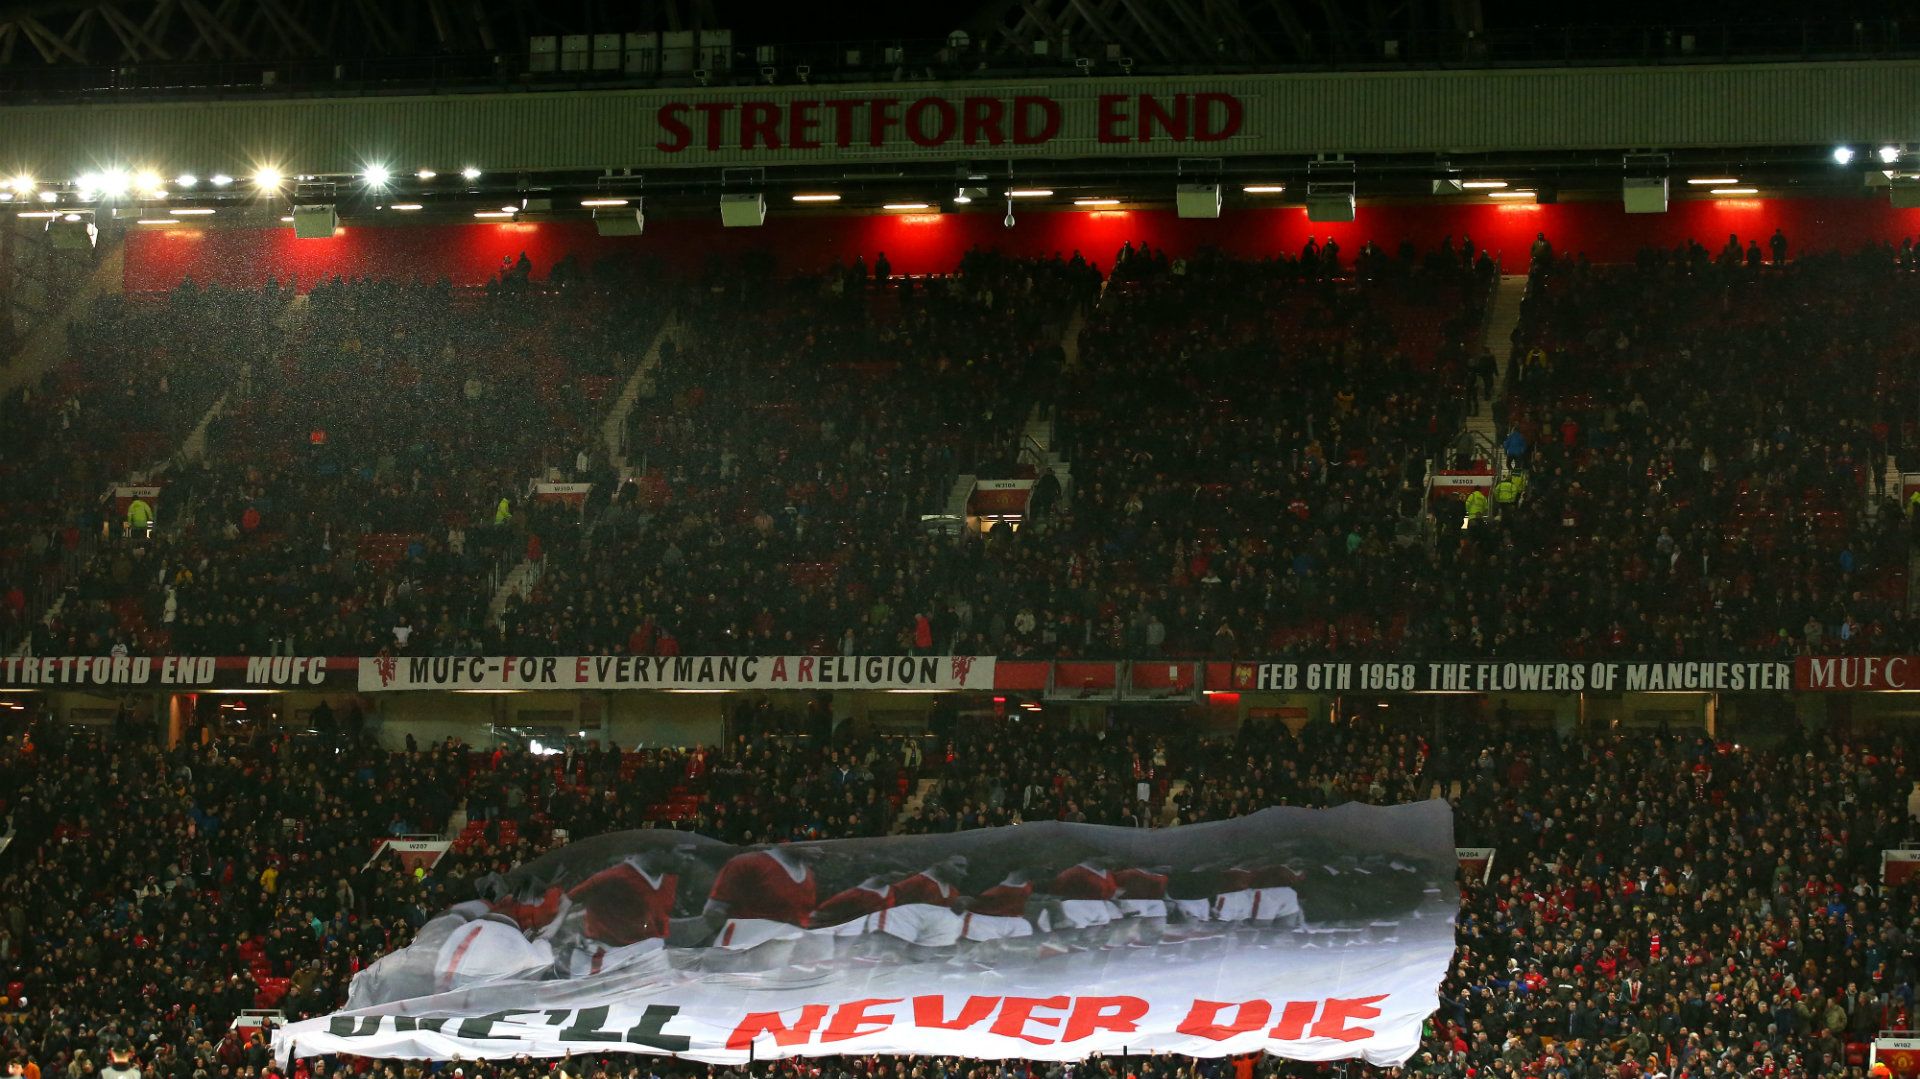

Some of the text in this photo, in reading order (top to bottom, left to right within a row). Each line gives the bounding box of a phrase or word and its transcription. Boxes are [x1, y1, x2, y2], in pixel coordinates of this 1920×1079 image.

[656, 91, 1244, 153] STRETFORD END
[0, 656, 327, 685] TRETFORD END MUFC
[771, 656, 788, 682] A
[797, 656, 939, 683] RELIGION
[1257, 662, 1790, 690] FEB 6TH 1958 THE FLOWERS OF MANCHESTER
[1809, 657, 1907, 688] MUFC
[725, 995, 1149, 1050] NEVER
[1177, 994, 1391, 1042] DIE
